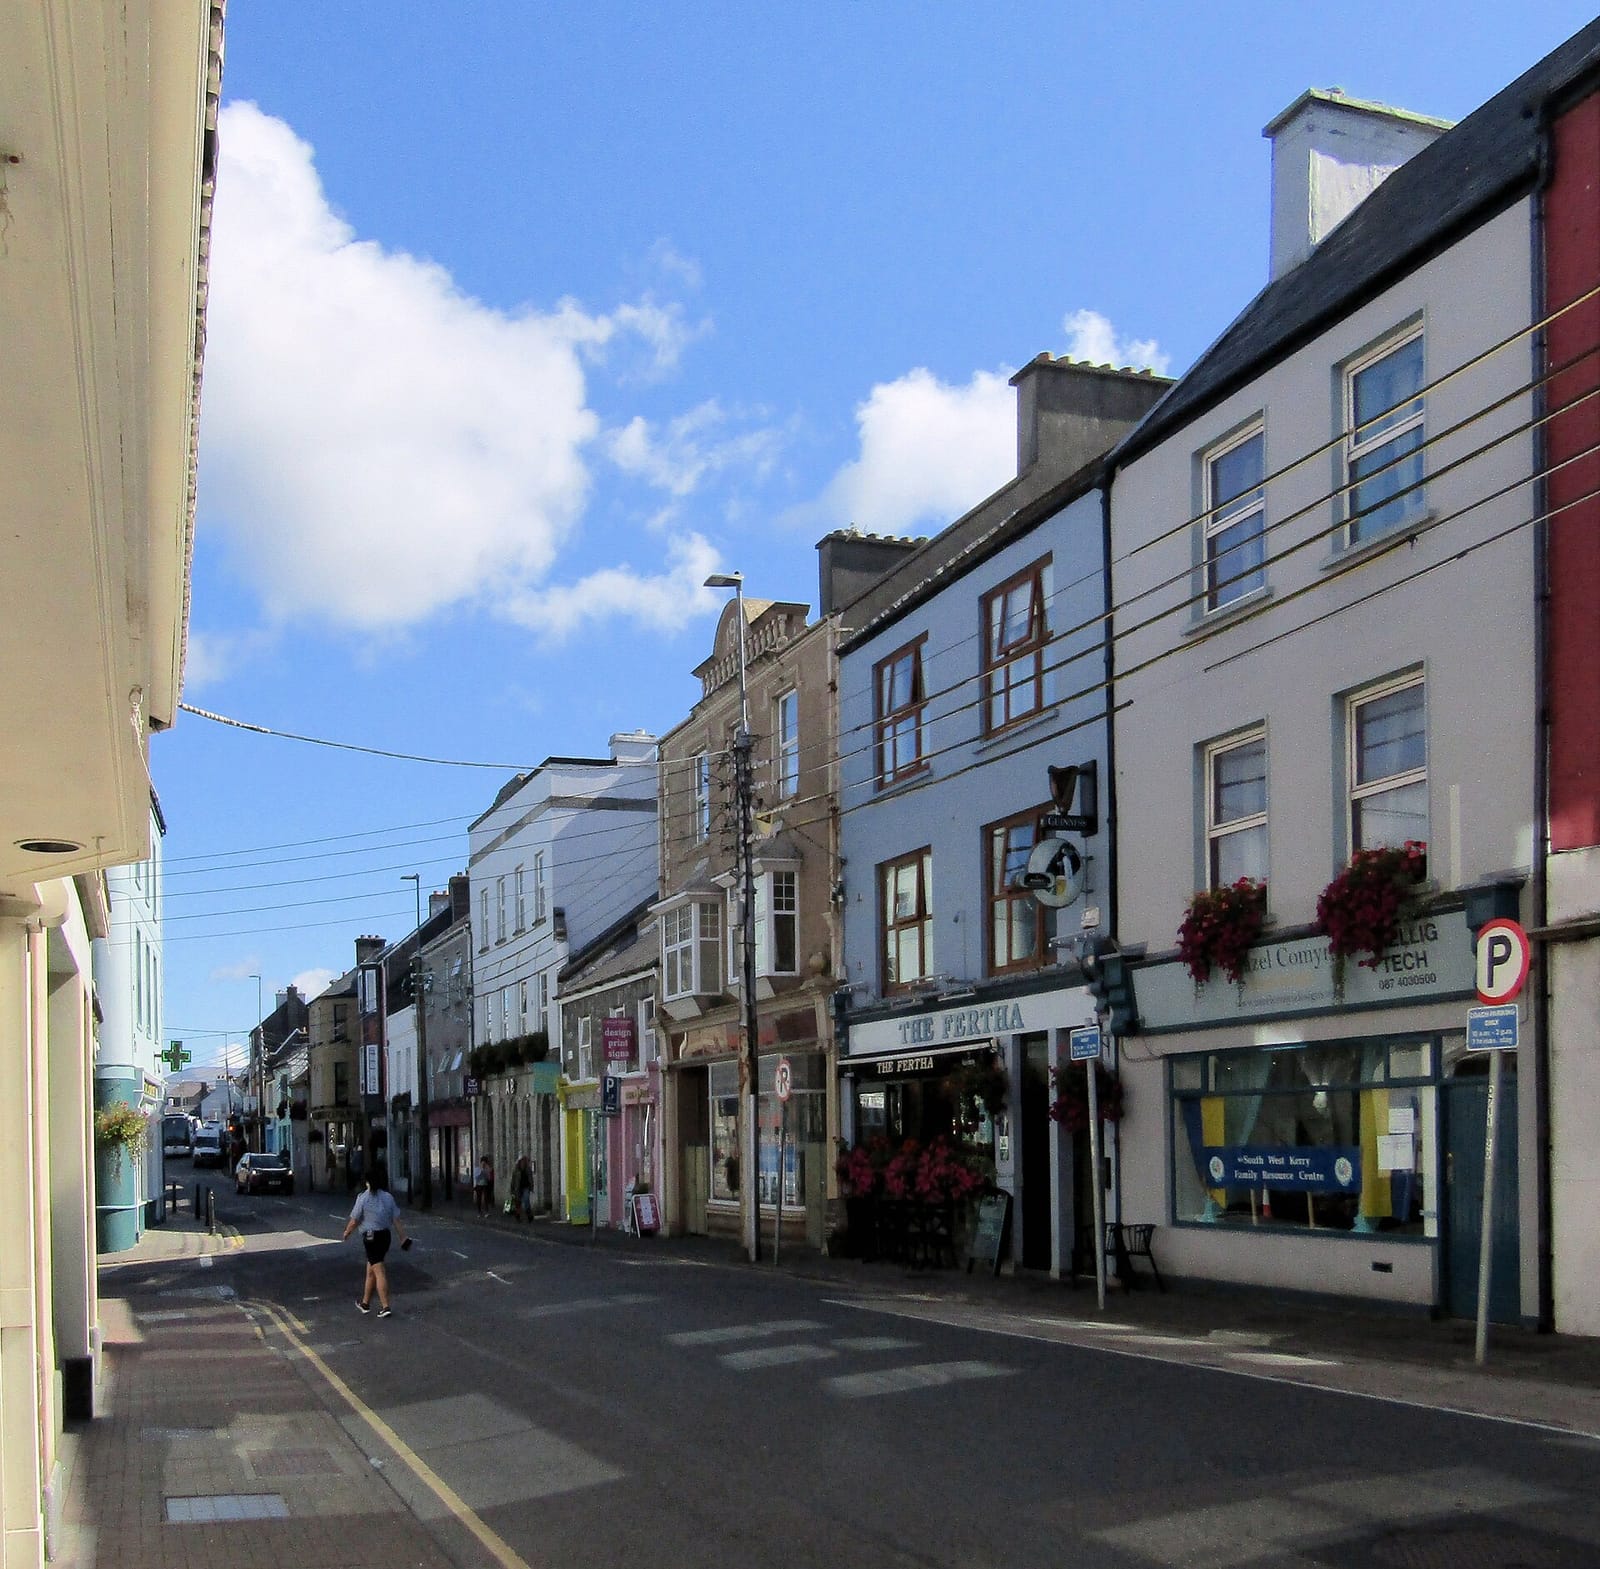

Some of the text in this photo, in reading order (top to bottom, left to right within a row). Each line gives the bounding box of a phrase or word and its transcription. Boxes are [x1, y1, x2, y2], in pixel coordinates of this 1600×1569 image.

[1383, 951, 1428, 973] TECH
[1487, 935, 1512, 989] P
[898, 1003, 1025, 1045] THE FERTHA
[604, 1027, 632, 1038] design
[608, 1039, 628, 1049] print
[876, 1057, 934, 1074] THE FERTHA
[606, 1078, 615, 1093] P
[1243, 1155, 1264, 1166] South
[1268, 1155, 1285, 1166] West
[1289, 1155, 1311, 1168] Kerry
[1234, 1169, 1325, 1182] Family Resource Centre
